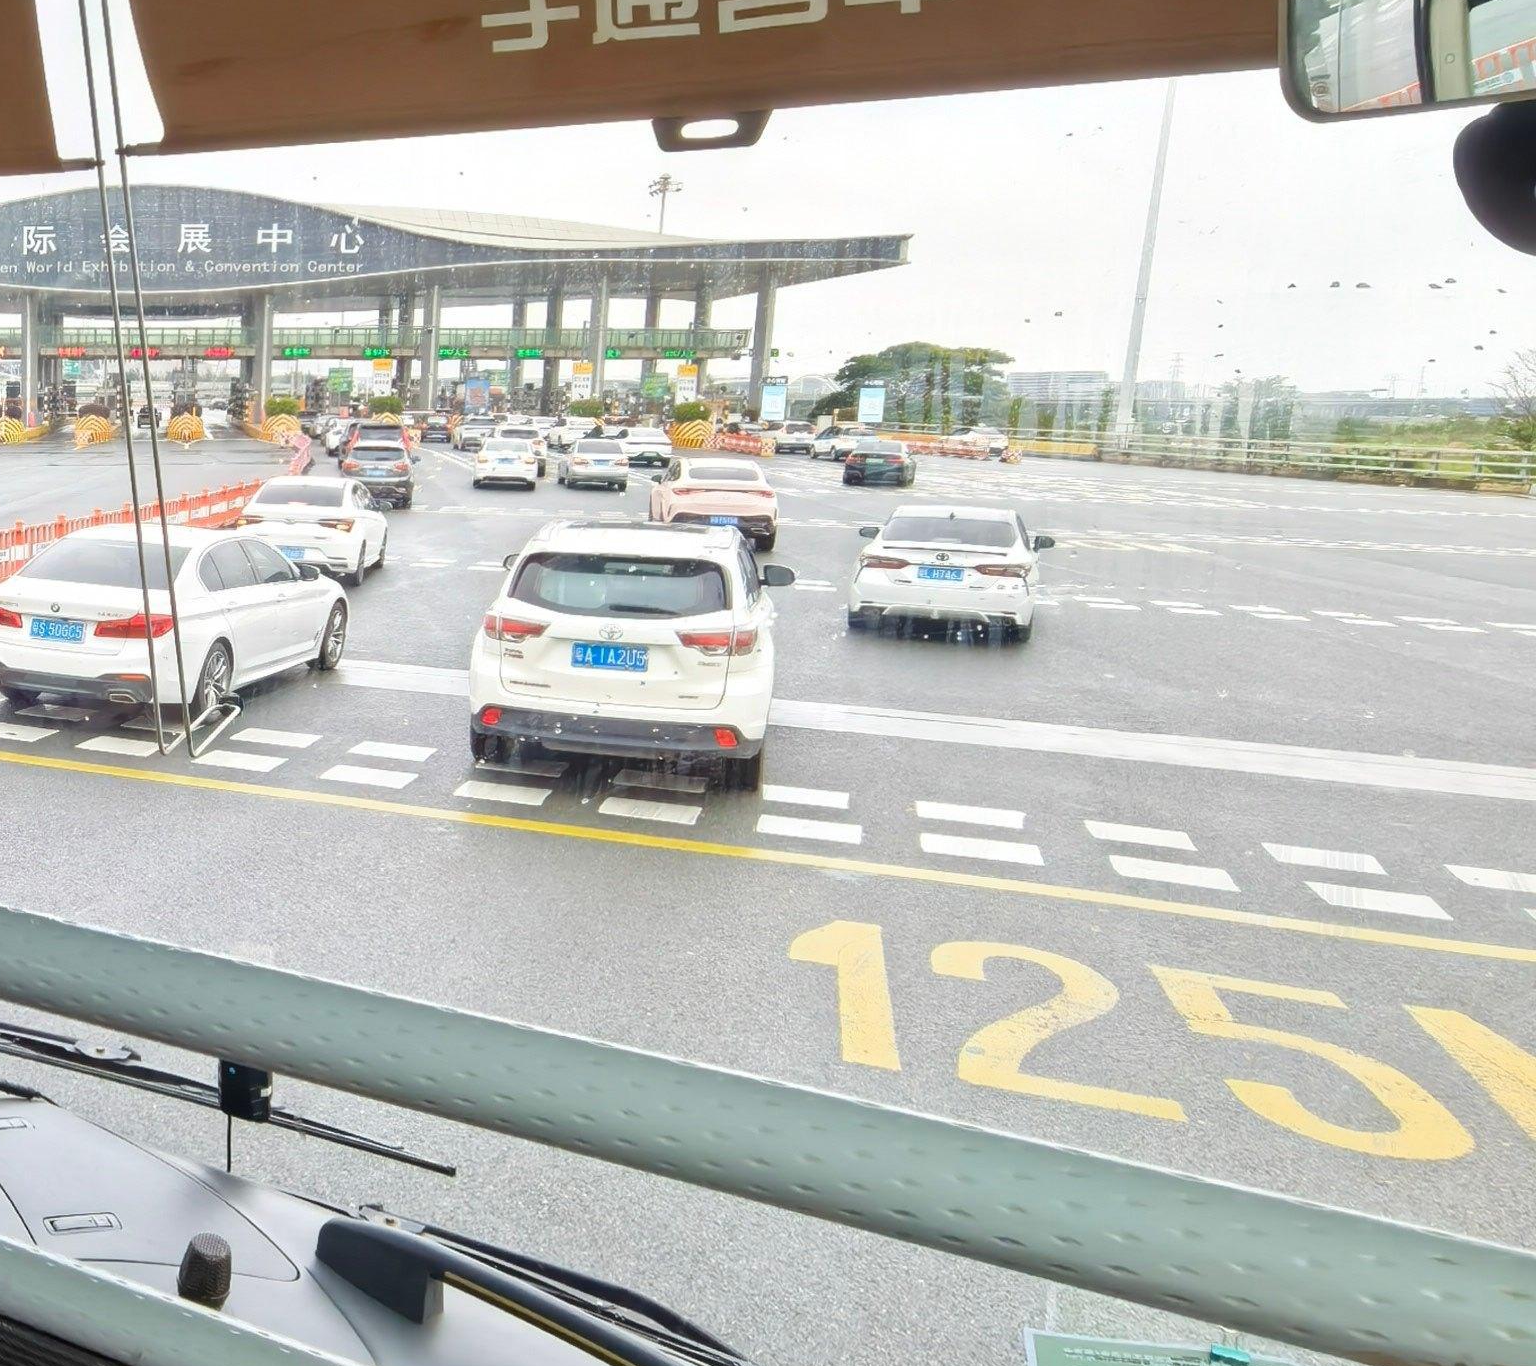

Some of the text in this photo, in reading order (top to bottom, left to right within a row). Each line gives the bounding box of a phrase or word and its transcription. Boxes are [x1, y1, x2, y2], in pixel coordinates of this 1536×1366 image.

[26, 260, 72, 273] World
[204, 260, 300, 273] Convention
[307, 260, 364, 273] Center
